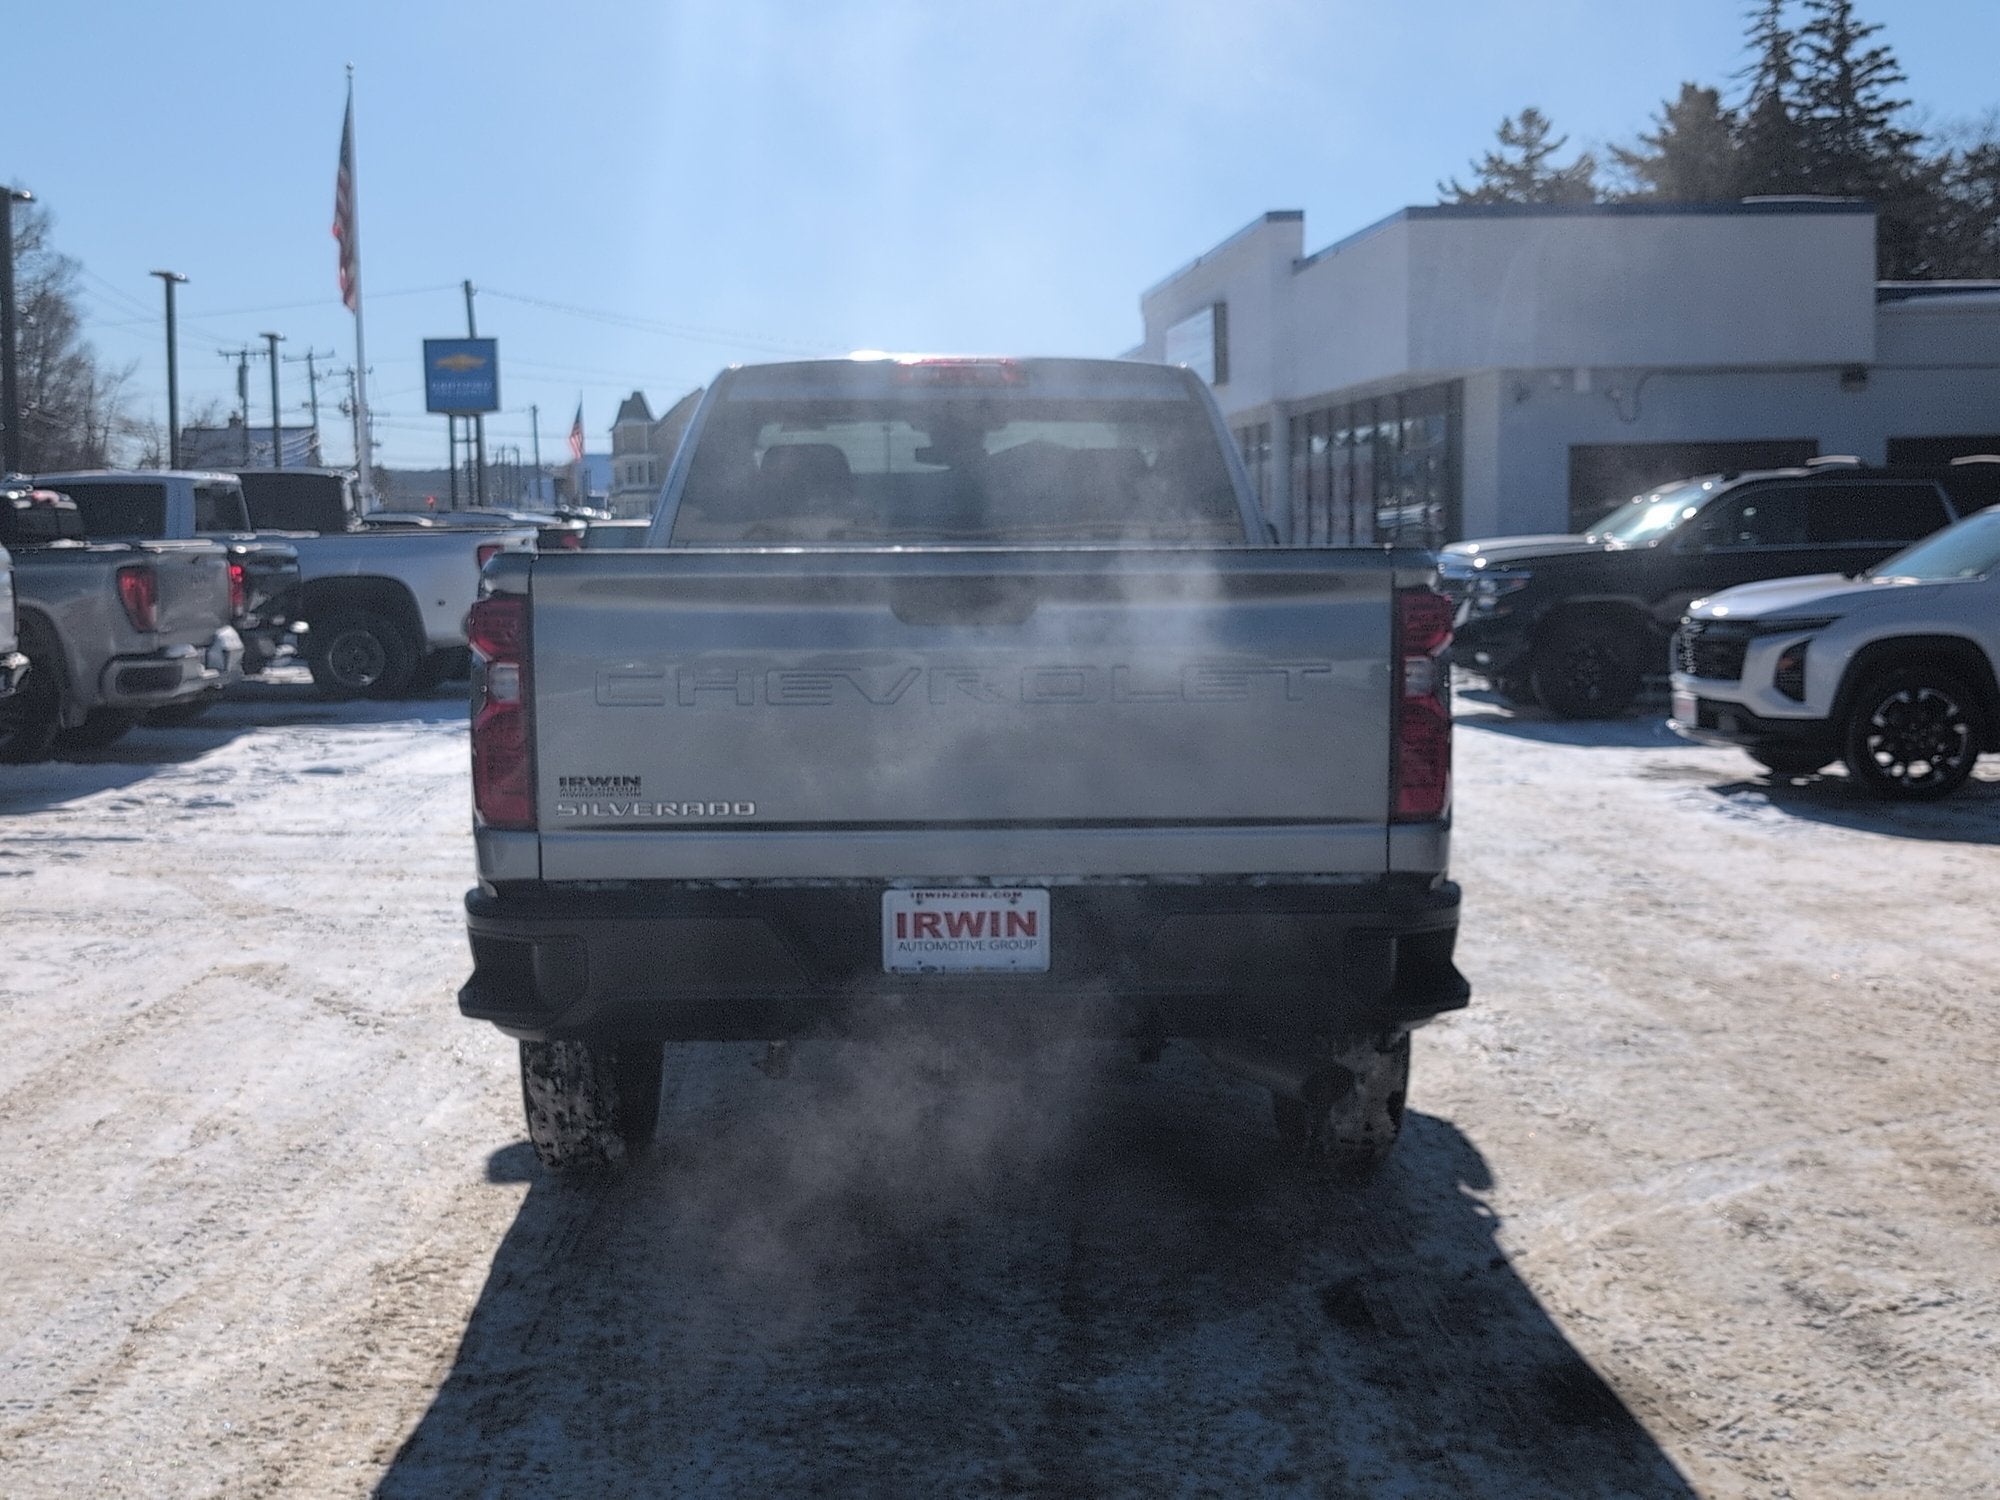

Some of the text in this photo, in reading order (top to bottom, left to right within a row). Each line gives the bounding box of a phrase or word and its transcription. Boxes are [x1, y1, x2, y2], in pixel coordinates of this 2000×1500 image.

[595, 662, 1331, 706] CHEVROLET
[559, 776, 642, 787] IRWIN
[557, 802, 757, 817] SILVERADO
[896, 911, 1037, 939] IRWIN
[899, 939, 1037, 952] AUTOMOTIVE GROUP
